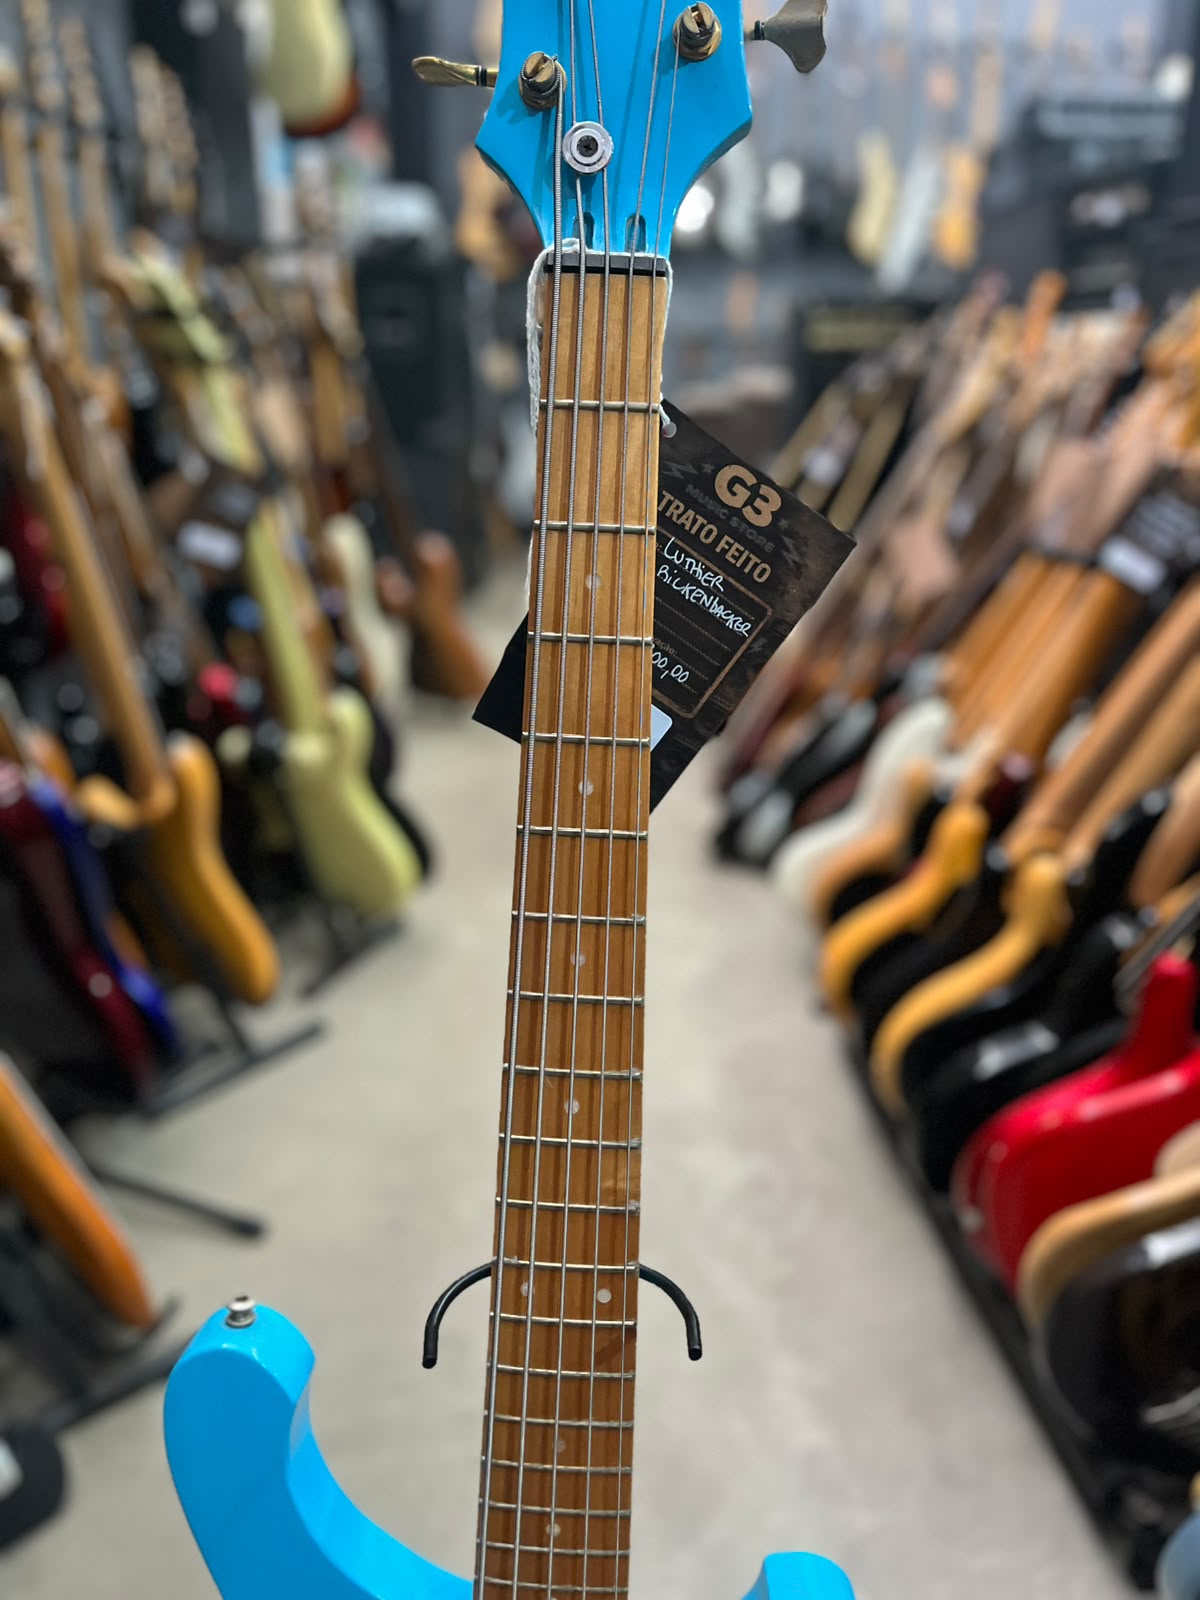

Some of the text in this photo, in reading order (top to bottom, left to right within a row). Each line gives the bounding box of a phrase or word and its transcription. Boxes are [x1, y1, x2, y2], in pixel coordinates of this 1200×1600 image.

[685, 483, 775, 553] MUSIC STORE
[714, 464, 782, 528] G3
[657, 489, 772, 584] TRATO FEITO
